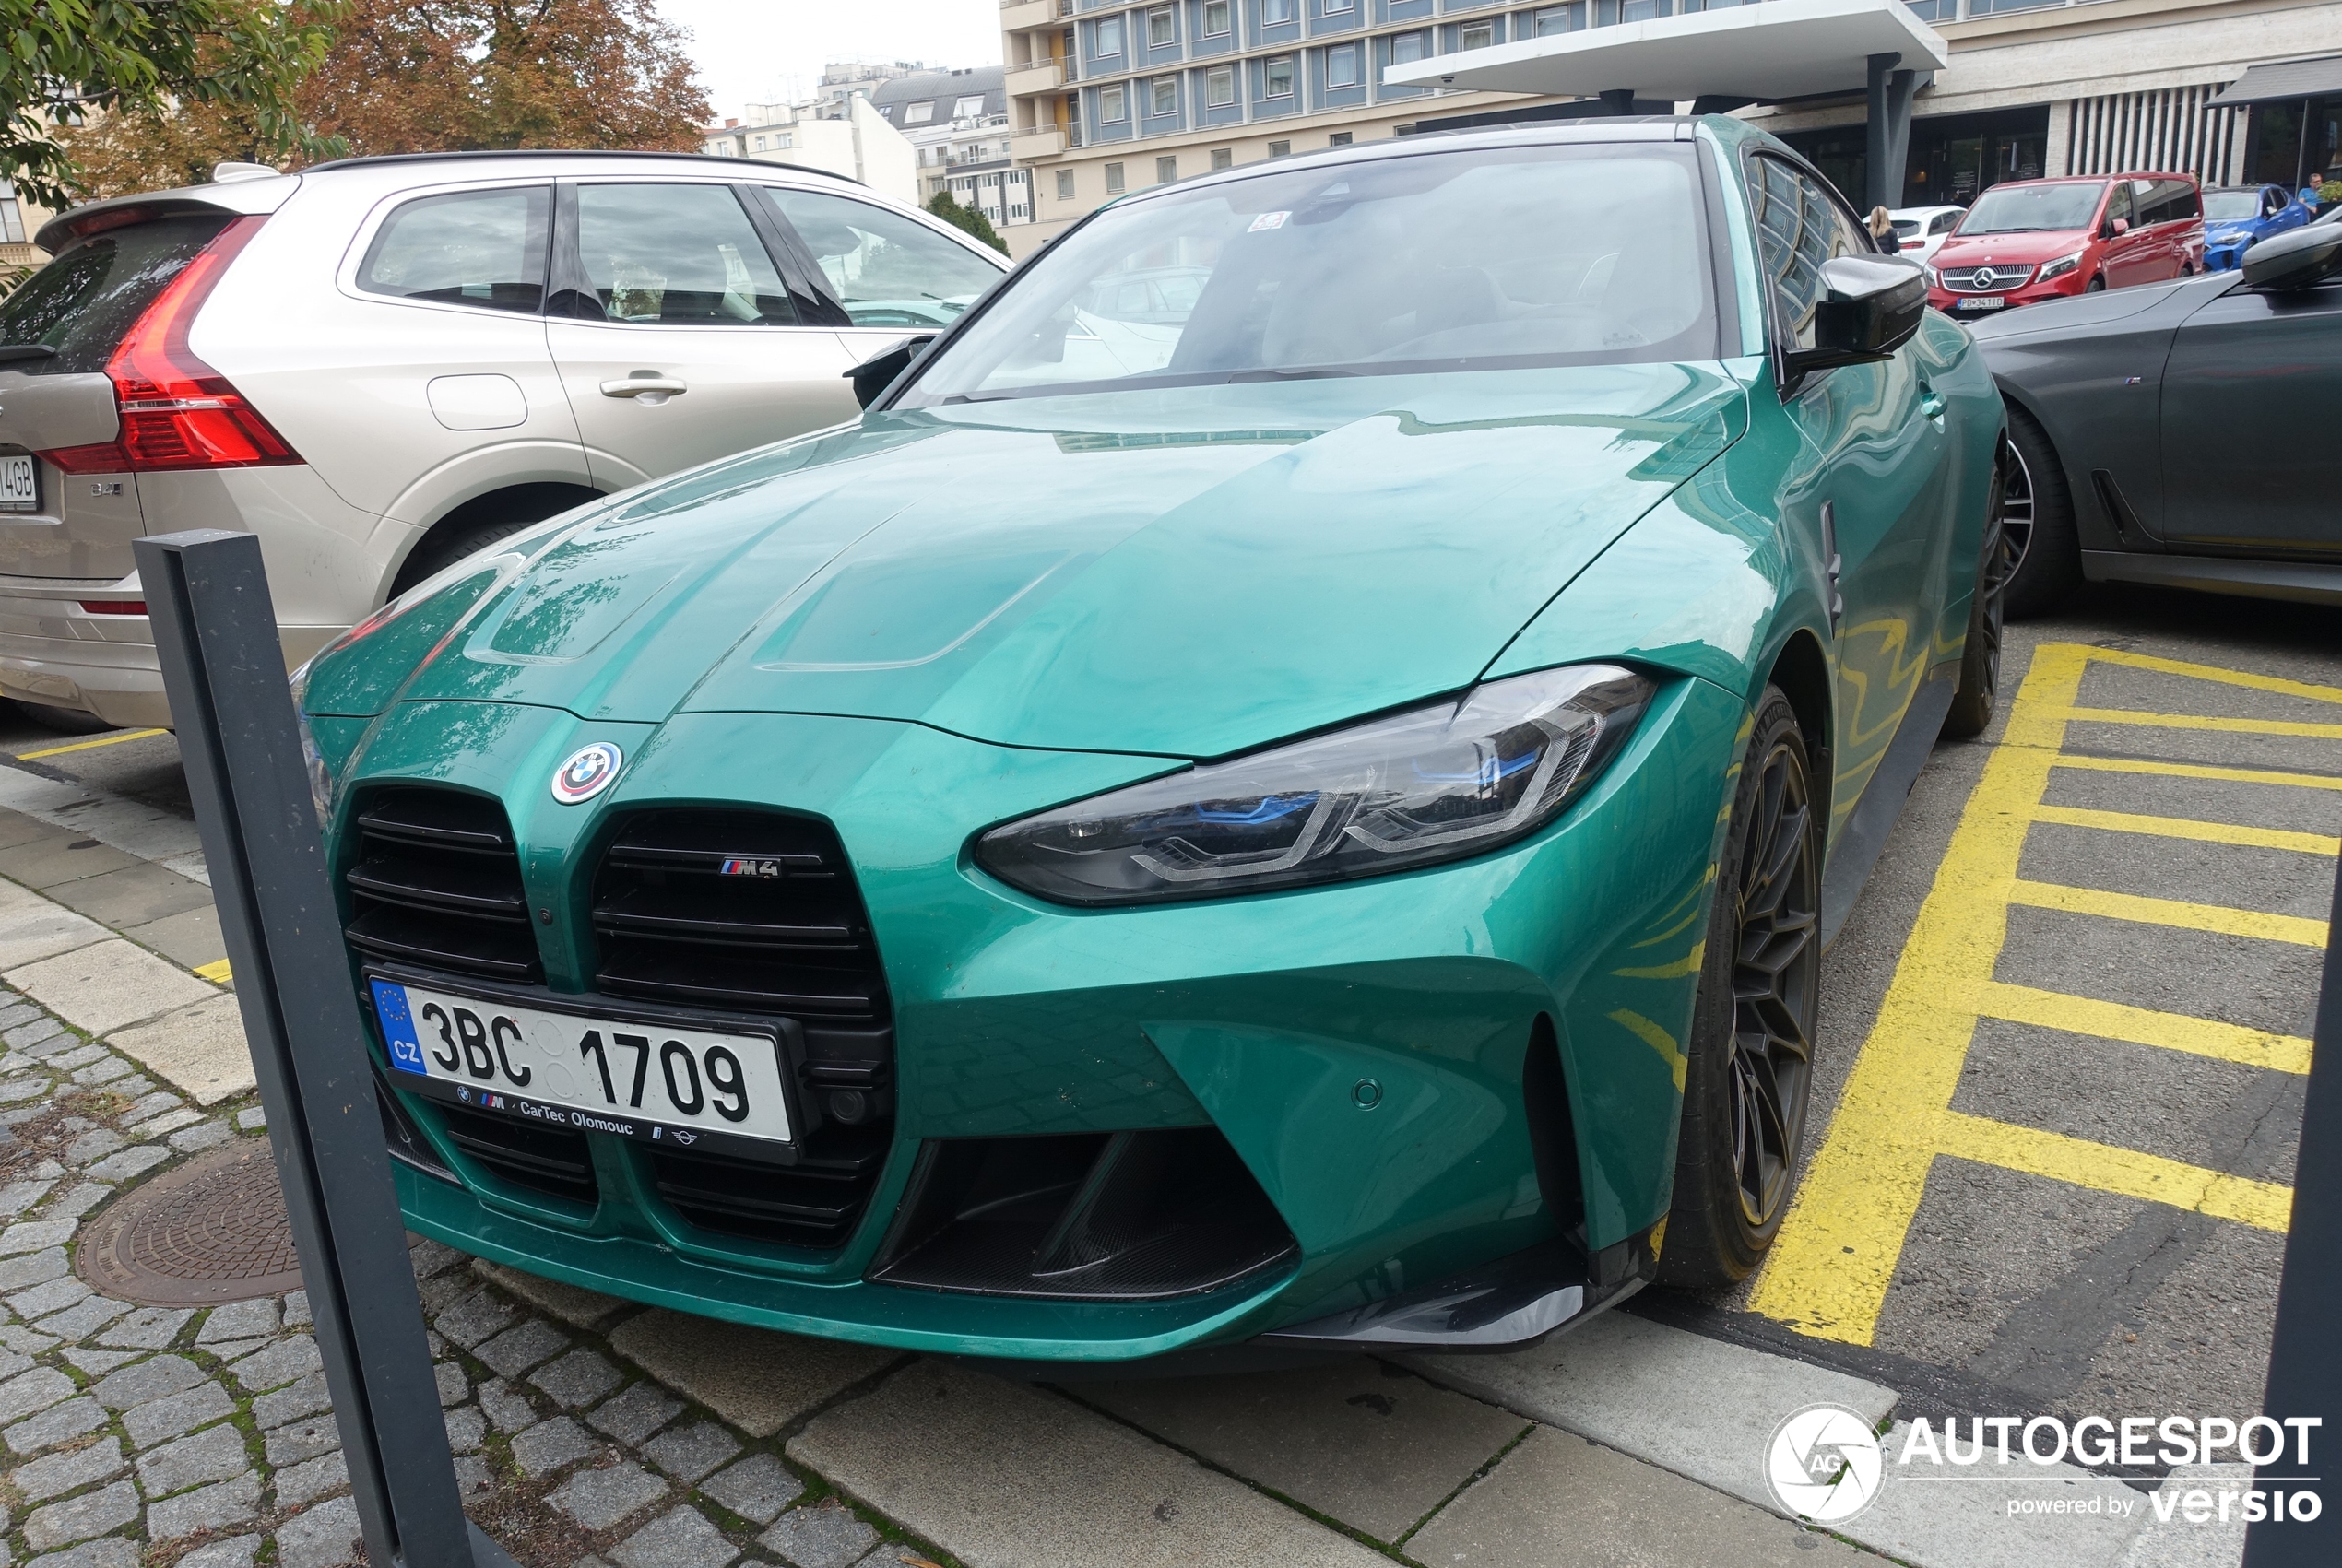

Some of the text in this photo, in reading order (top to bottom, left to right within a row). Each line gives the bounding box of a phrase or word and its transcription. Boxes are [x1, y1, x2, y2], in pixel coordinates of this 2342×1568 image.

[735, 860, 778, 876] M4
[394, 1040, 420, 1063] CZ
[421, 1002, 750, 1123] 3BC 1709
[520, 1101, 633, 1136] CarTec Olomouc
